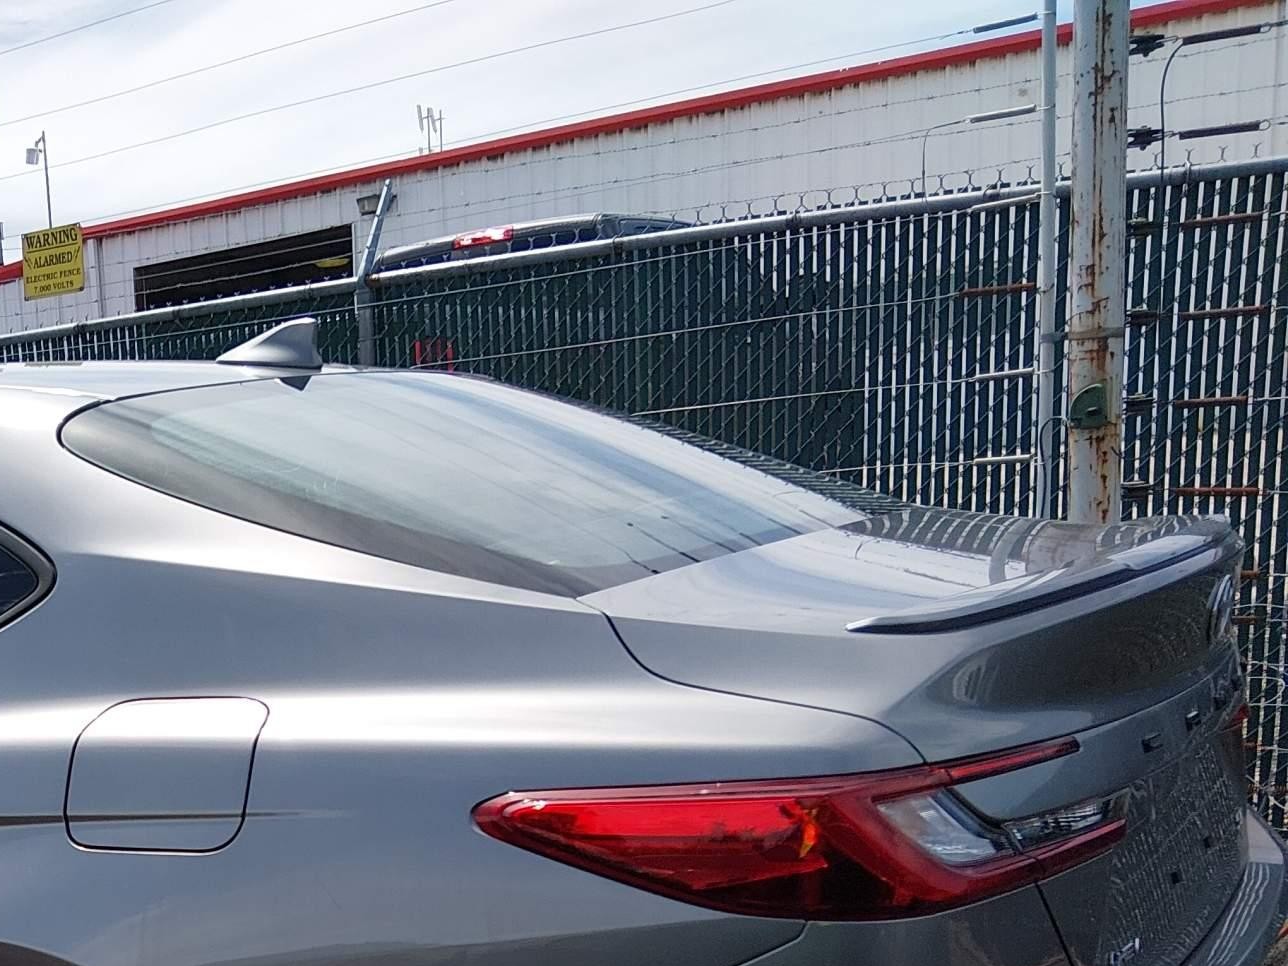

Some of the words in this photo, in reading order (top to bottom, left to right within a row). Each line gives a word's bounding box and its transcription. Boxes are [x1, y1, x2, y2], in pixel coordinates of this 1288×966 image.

[25, 227, 78, 250] WARNING
[33, 251, 73, 269] ALARMED
[25, 271, 58, 284] ELECTRIC
[59, 268, 81, 279] FENCE
[52, 279, 74, 290] VOLTS
